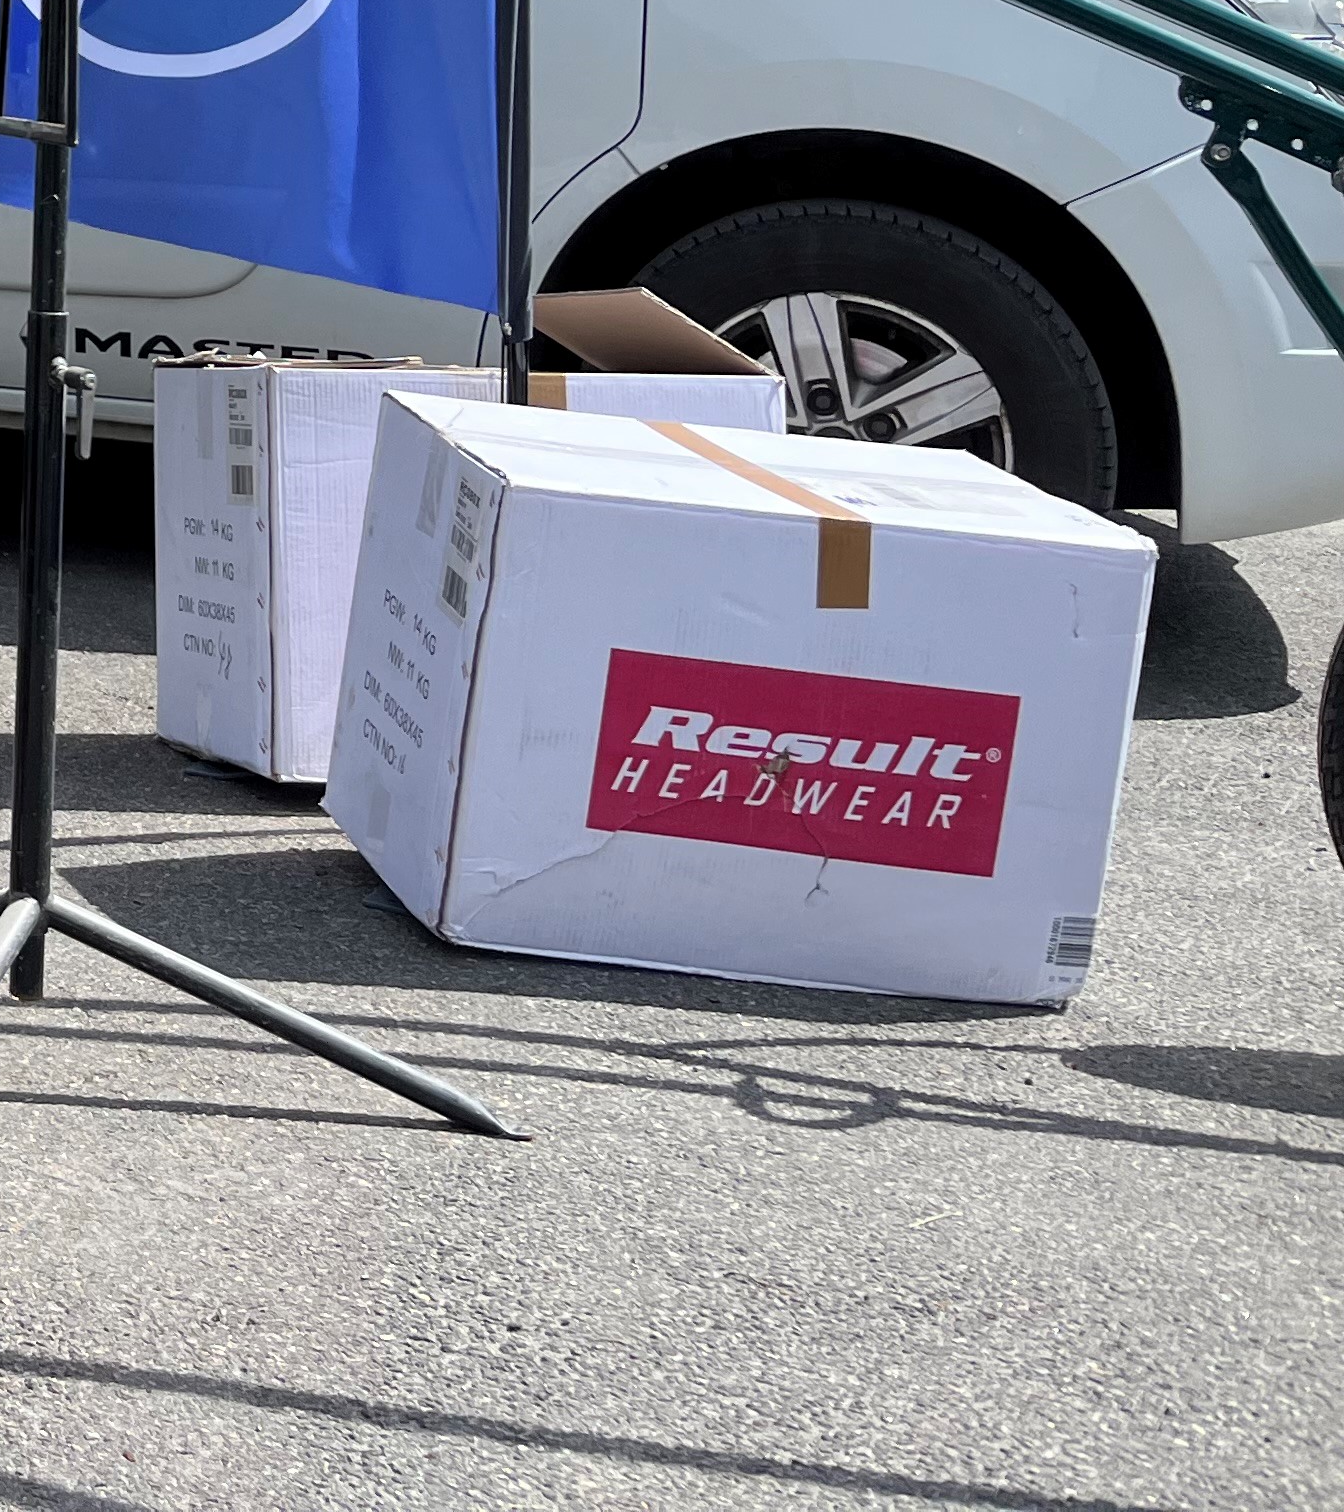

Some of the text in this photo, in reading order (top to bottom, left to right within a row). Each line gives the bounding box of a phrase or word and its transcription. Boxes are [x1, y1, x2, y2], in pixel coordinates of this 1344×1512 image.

[221, 522, 233, 542] KG
[223, 560, 234, 581] KG
[178, 594, 236, 624] DIM: 60X38X45
[184, 633, 200, 653] CTN
[201, 637, 216, 658] NO:
[413, 613, 422, 636] 14
[422, 626, 437, 656] KG
[407, 658, 416, 682] 11
[416, 671, 430, 700] KG
[363, 718, 381, 752] CTN
[383, 692, 424, 749] 60X38X45
[631, 705, 982, 782] Result
[611, 756, 963, 829] HEADWEAR
